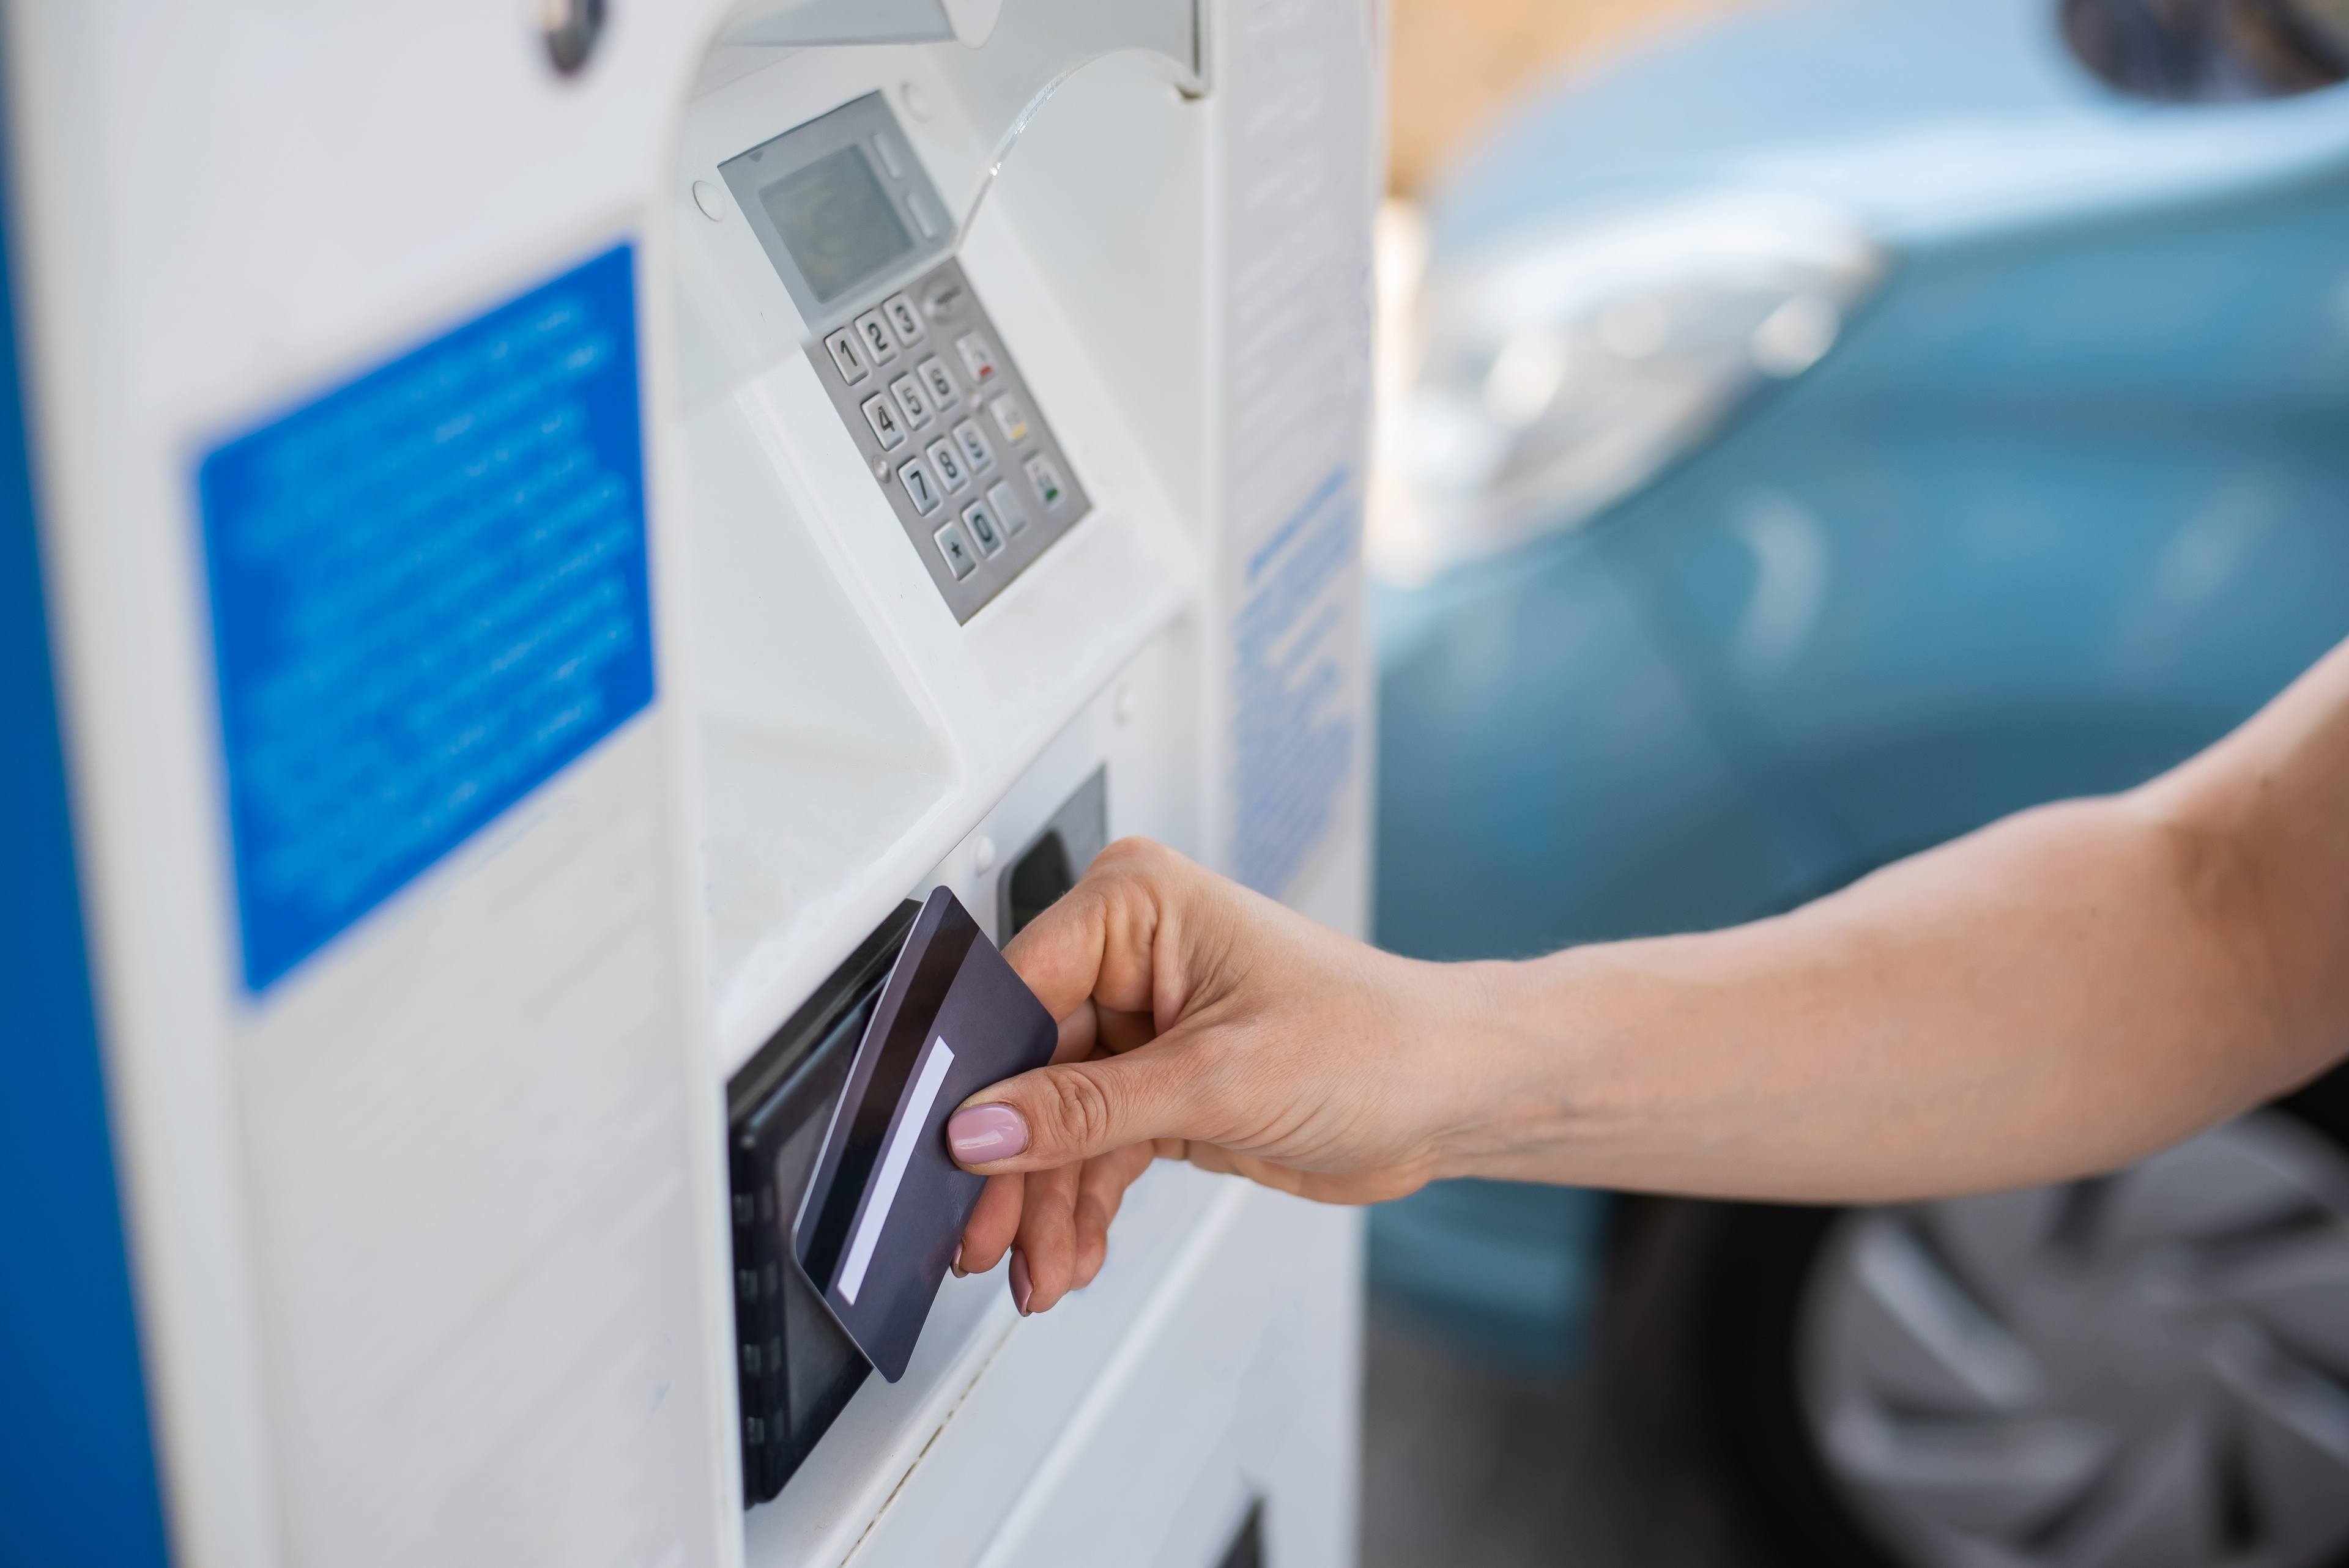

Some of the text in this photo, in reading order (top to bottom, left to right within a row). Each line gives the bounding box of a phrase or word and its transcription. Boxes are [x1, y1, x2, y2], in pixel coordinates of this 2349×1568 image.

[840, 305, 915, 367] 1 2 3
[877, 369, 950, 433] 4 5 6
[910, 431, 984, 500] 7 8 9
[974, 514, 993, 542] 0
